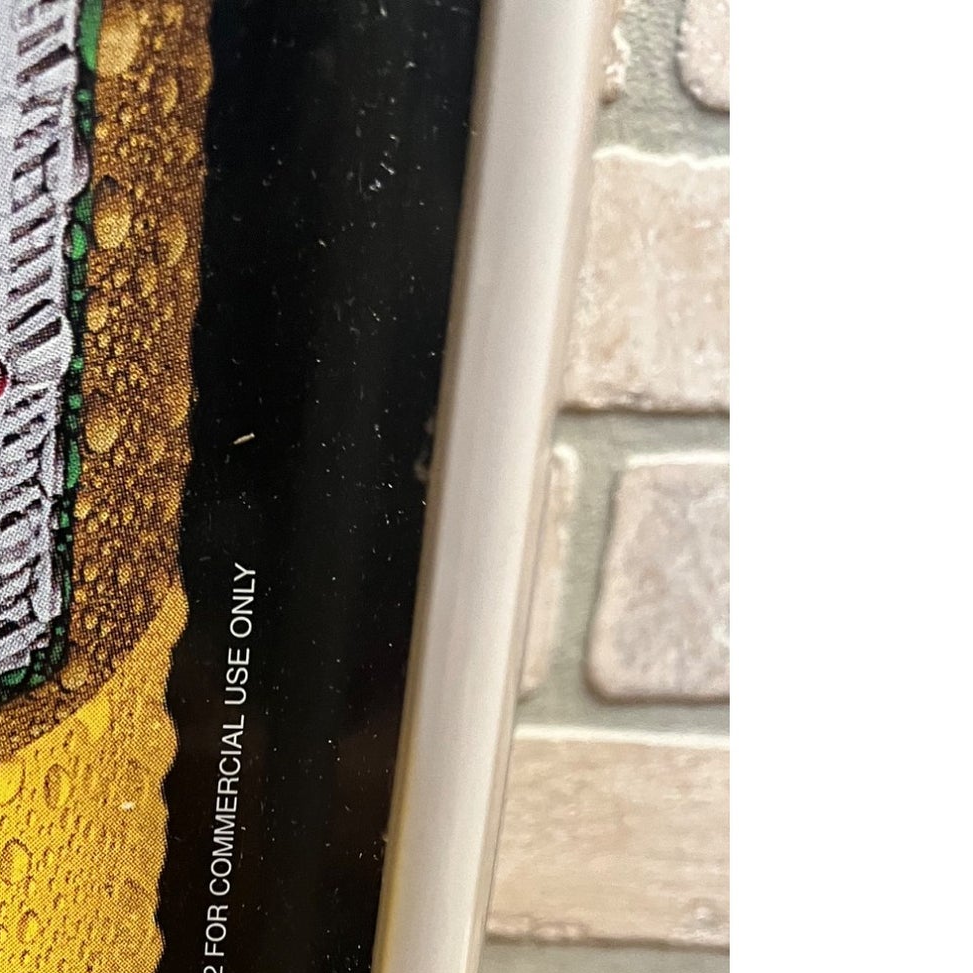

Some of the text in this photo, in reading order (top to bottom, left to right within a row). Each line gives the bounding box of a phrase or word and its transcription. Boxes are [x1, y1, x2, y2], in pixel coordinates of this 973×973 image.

[229, 562, 256, 638] ONLY
[224, 647, 250, 705] USE
[209, 714, 245, 896] COMMERCIAL
[204, 904, 229, 957] FOR
